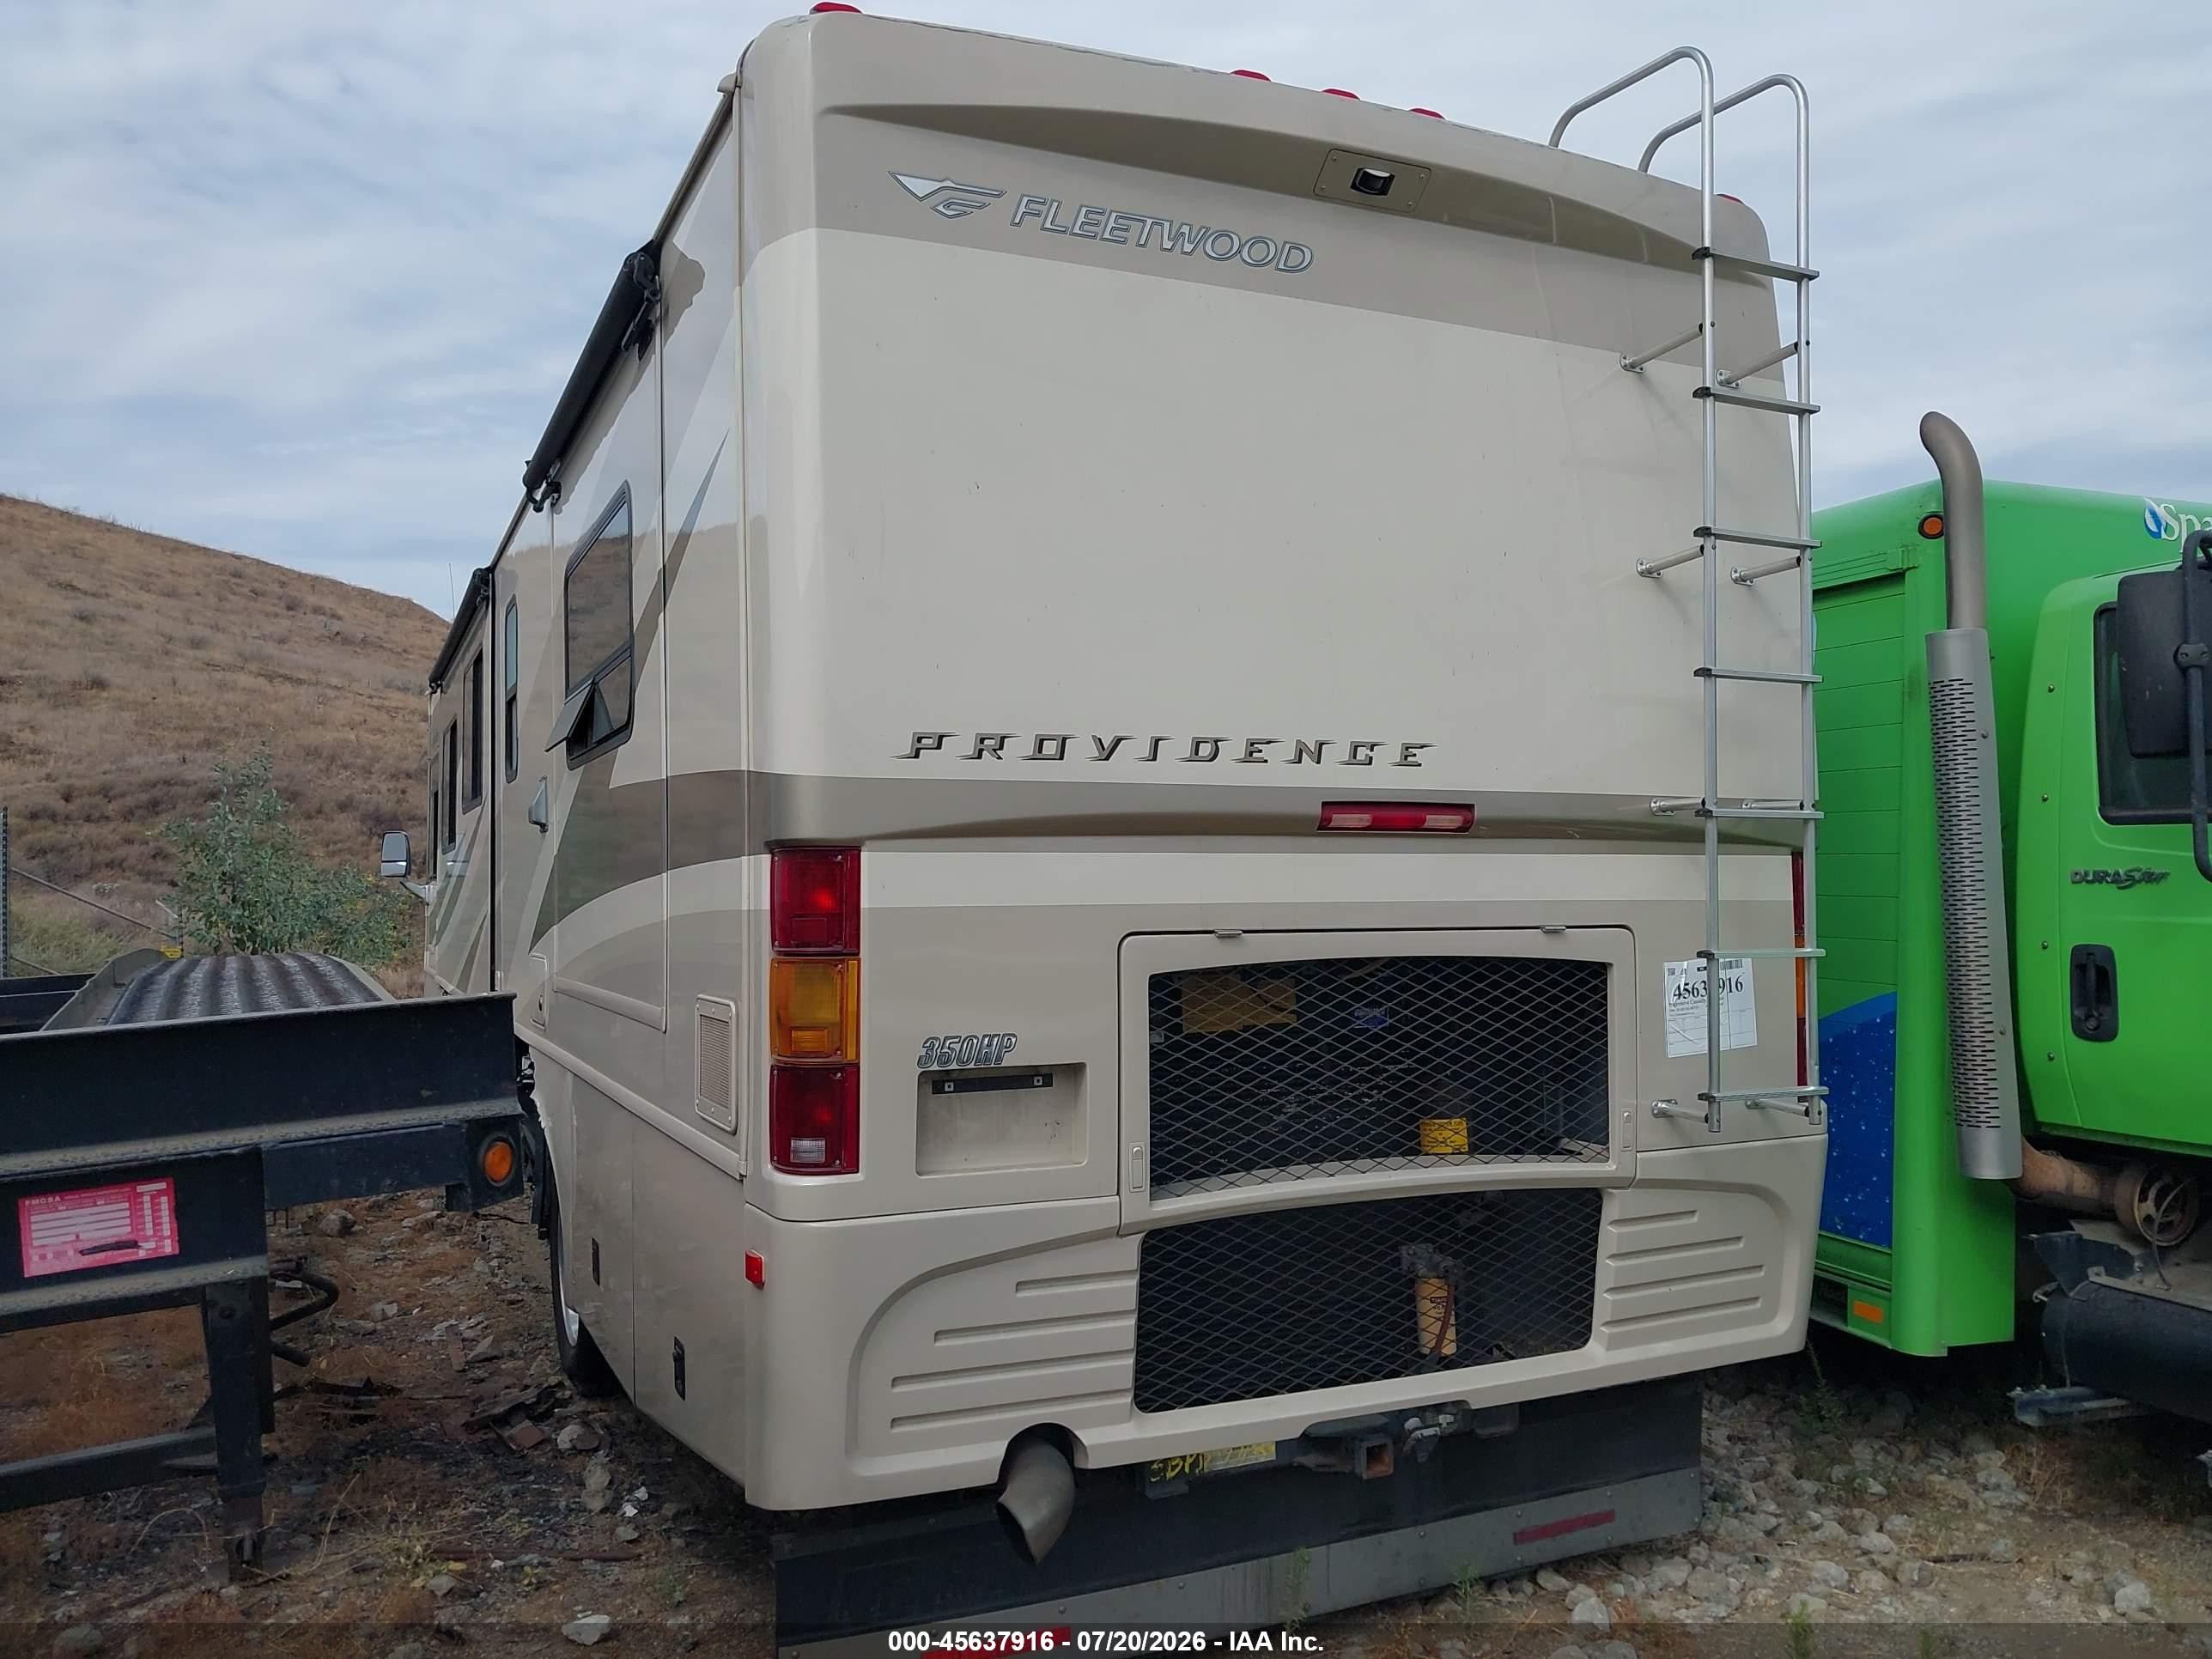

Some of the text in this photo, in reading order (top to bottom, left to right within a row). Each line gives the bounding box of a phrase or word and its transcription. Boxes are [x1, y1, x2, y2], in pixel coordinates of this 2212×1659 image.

[1009, 192, 1315, 275] FLEETWOOD
[890, 731, 1438, 768] PROVIDENCE
[1673, 975, 1743, 1000] 4563916
[917, 1033, 1018, 1068] 350HP
